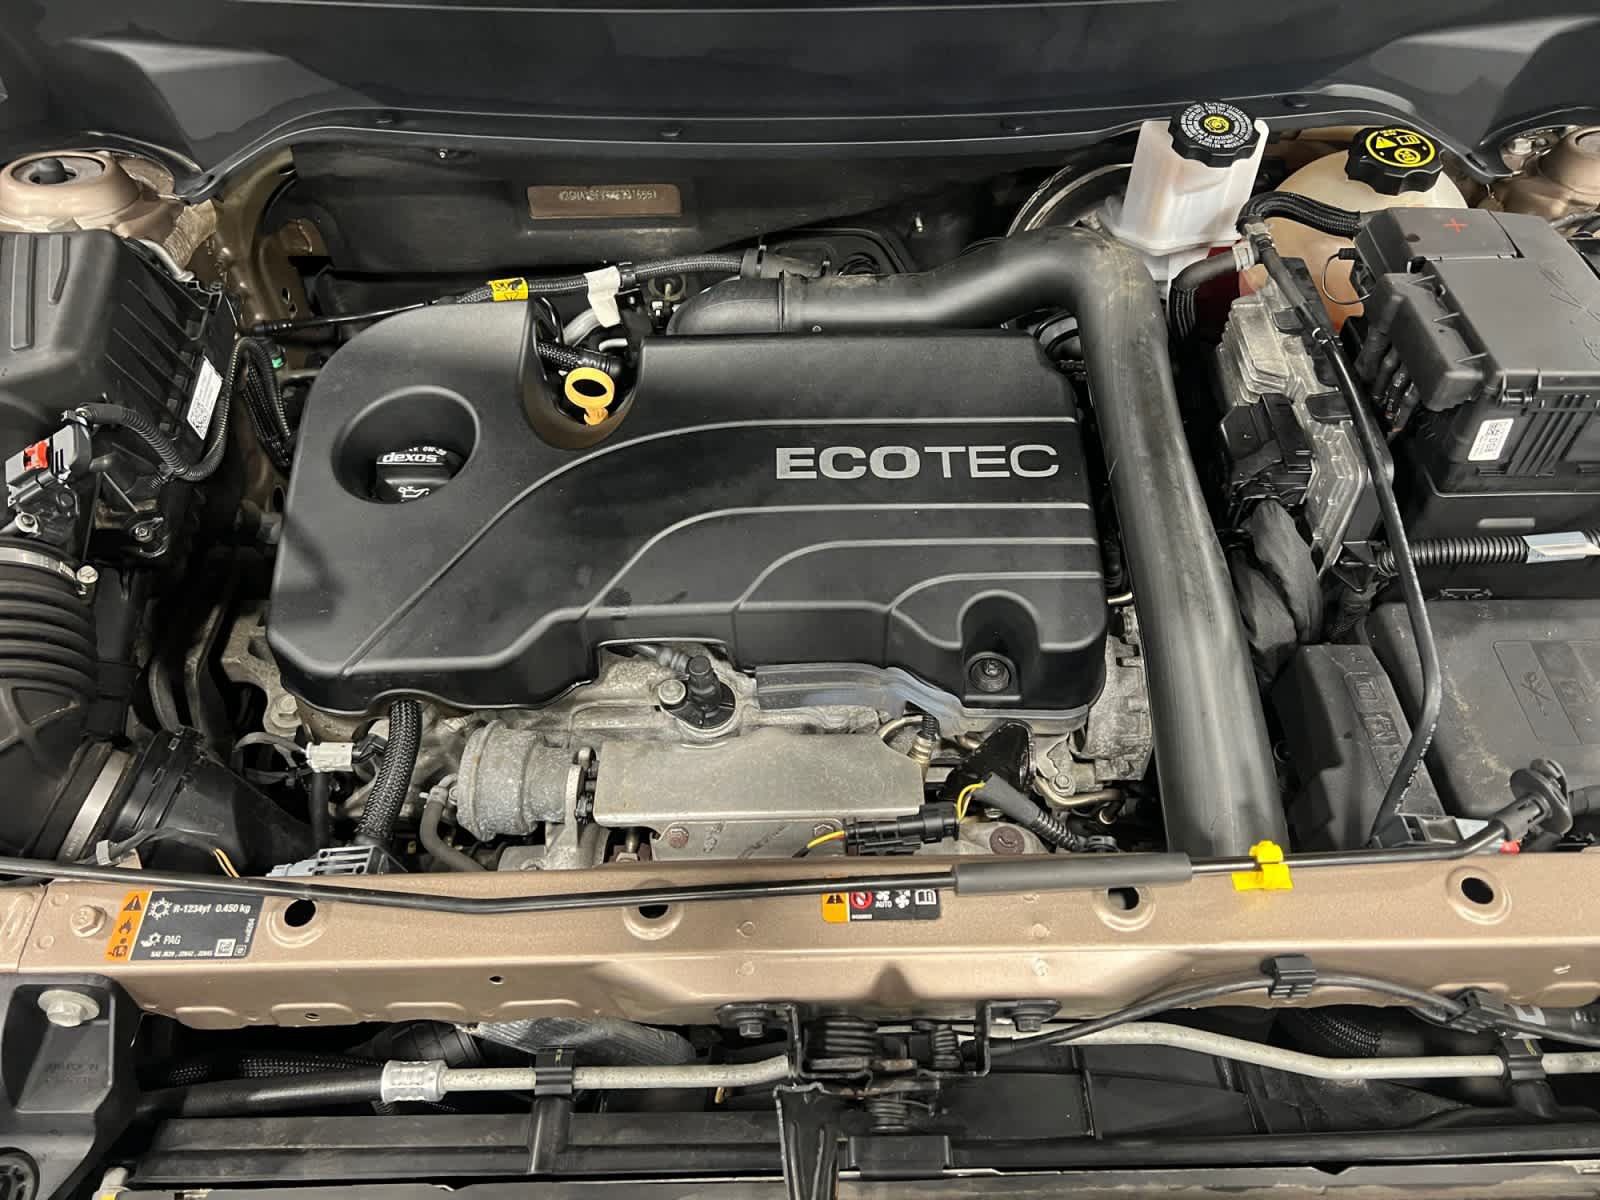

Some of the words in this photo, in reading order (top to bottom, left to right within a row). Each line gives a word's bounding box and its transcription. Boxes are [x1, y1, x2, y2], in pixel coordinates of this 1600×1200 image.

[382, 452, 440, 463] dexos
[776, 445, 1060, 479] ECOTEC
[172, 903, 212, 915] R-1234yf
[215, 903, 239, 913] 0.450
[239, 903, 251, 914] kg
[875, 900, 892, 908] AUTO
[163, 935, 181, 945] PAG
